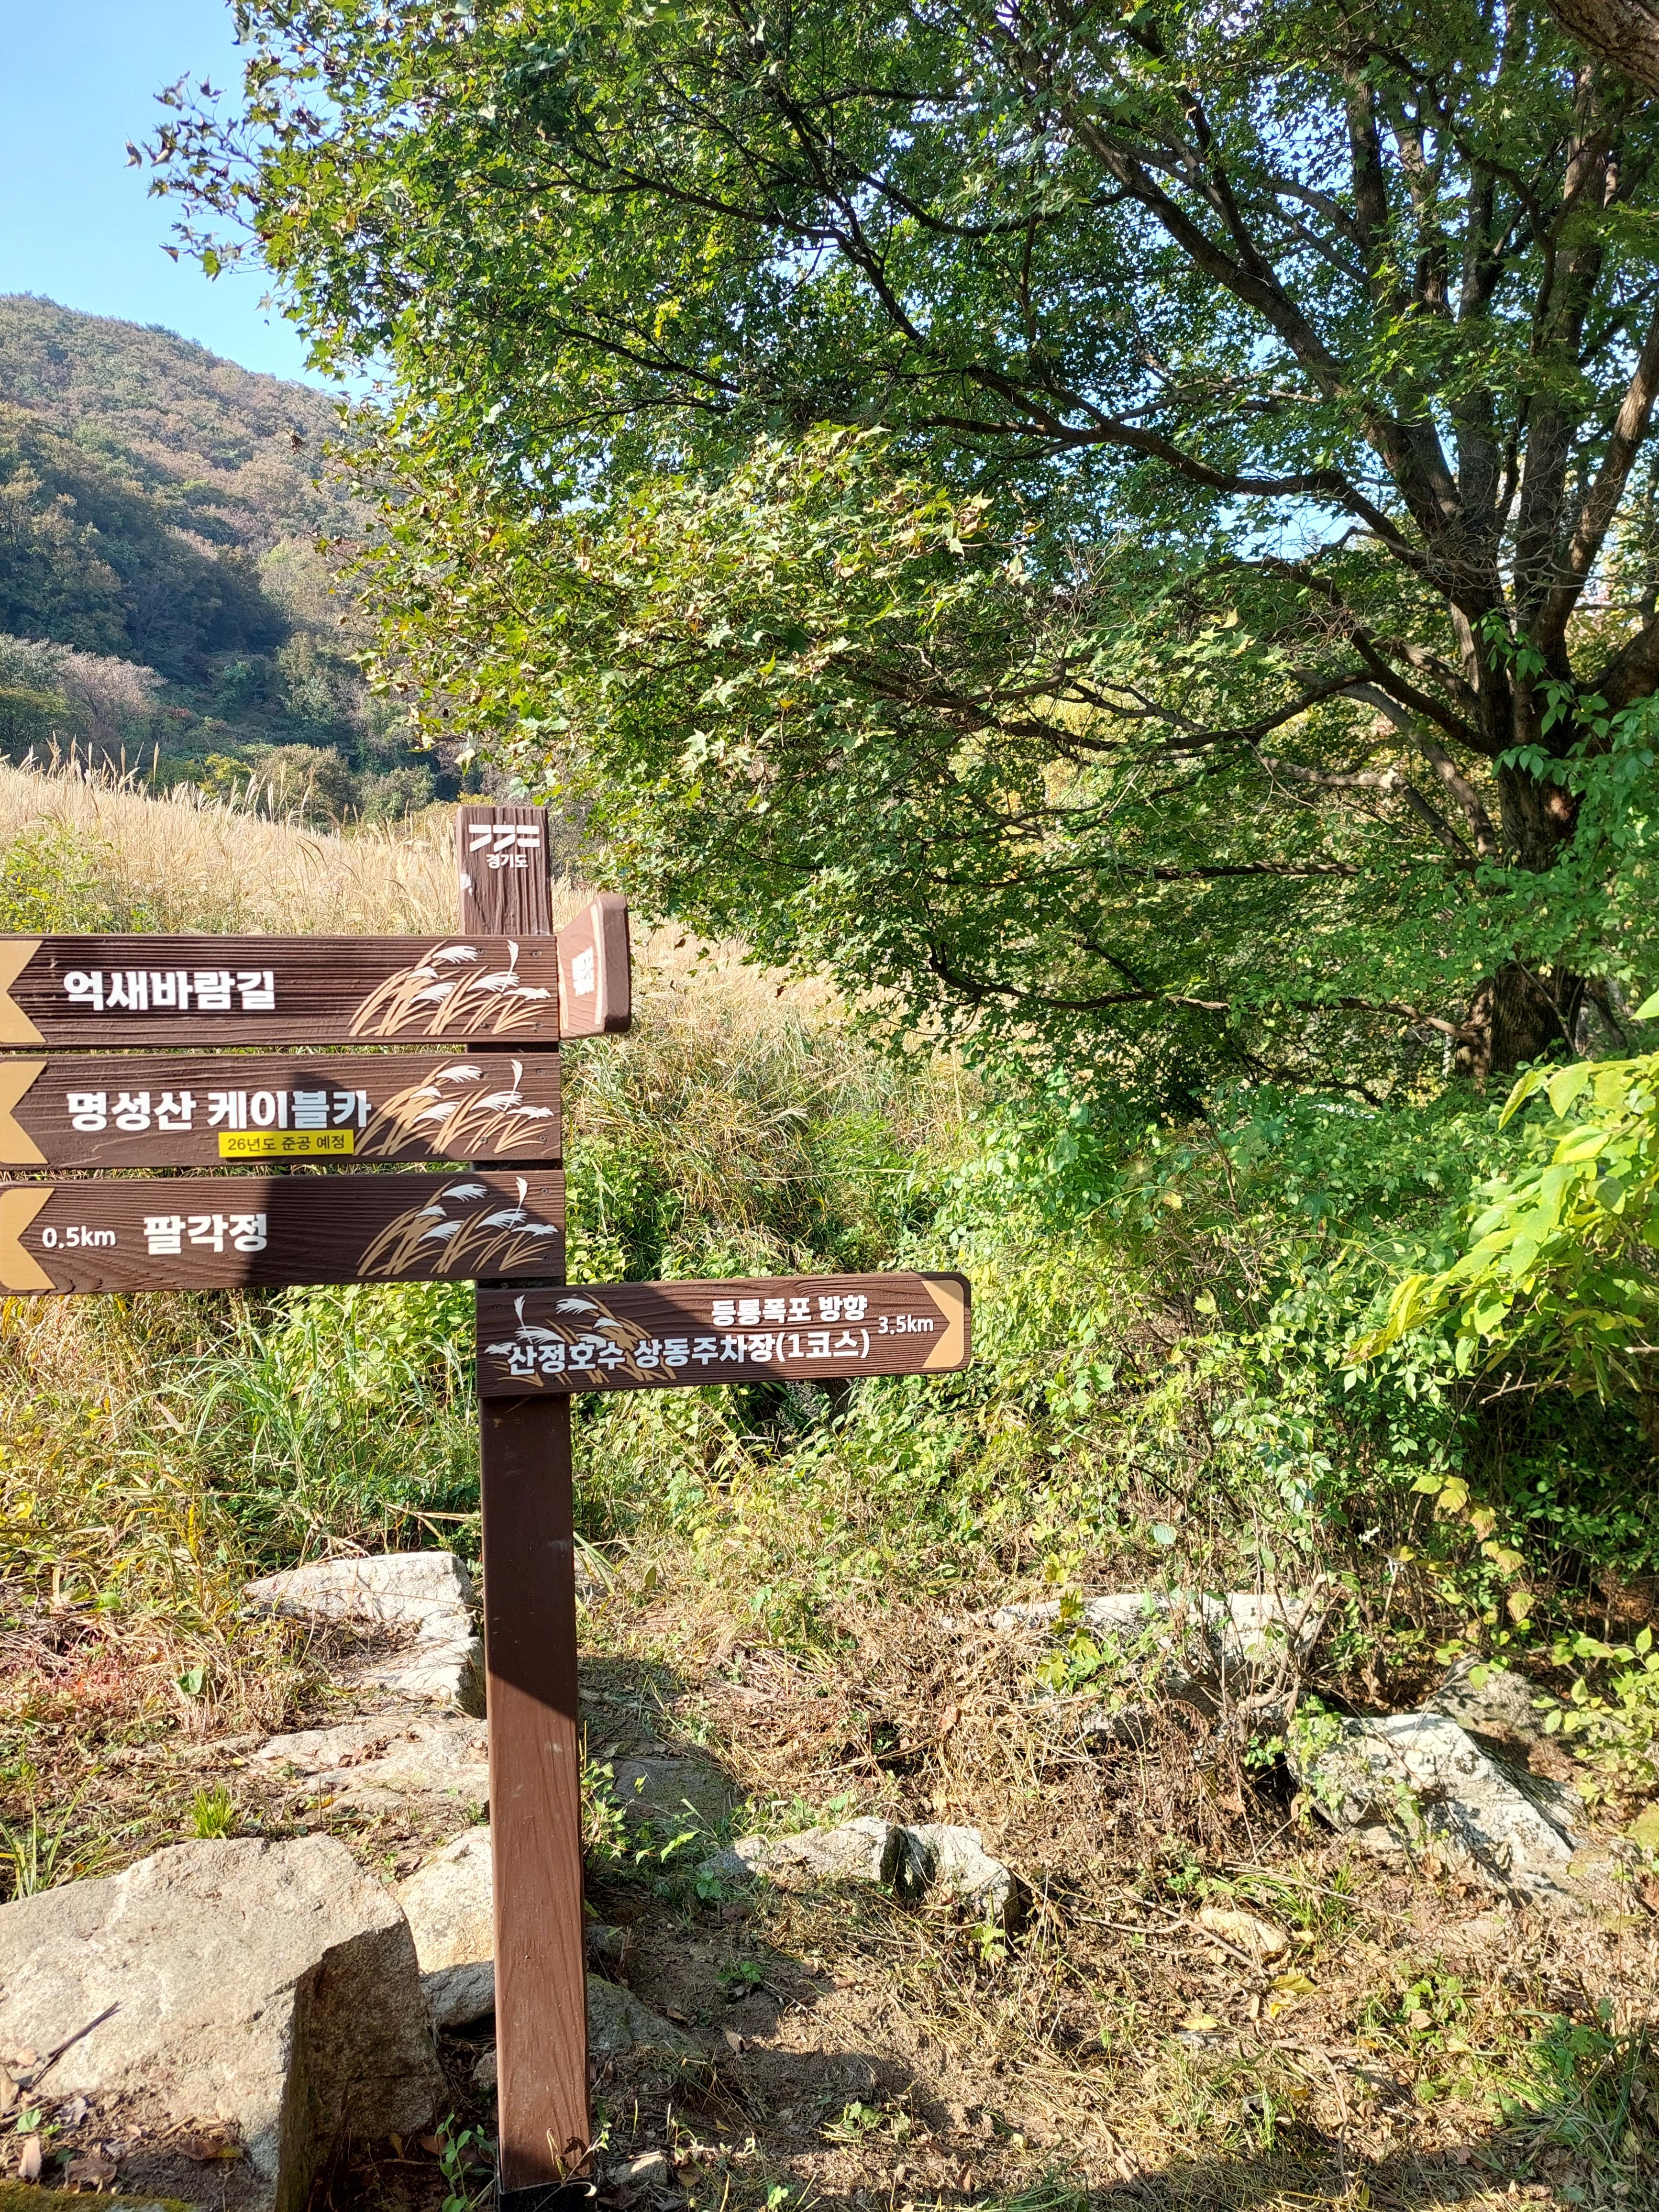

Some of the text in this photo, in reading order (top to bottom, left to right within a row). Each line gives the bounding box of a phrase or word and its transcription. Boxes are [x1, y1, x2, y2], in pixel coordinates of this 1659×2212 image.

[486, 854, 528, 869] 경기도
[63, 971, 276, 1010] 억새바람길
[66, 1091, 372, 1132] 명성산 케이블카
[227, 1134, 344, 1151] 26년도 준공 예정
[42, 1226, 116, 1249] 0.5km
[143, 1213, 268, 1255] 팔각정
[711, 1294, 868, 1327] 등룡폭포 방향
[877, 1315, 934, 1335] 3.5km
[507, 1328, 871, 1376] 산정호수 상동주차장(1코스)
